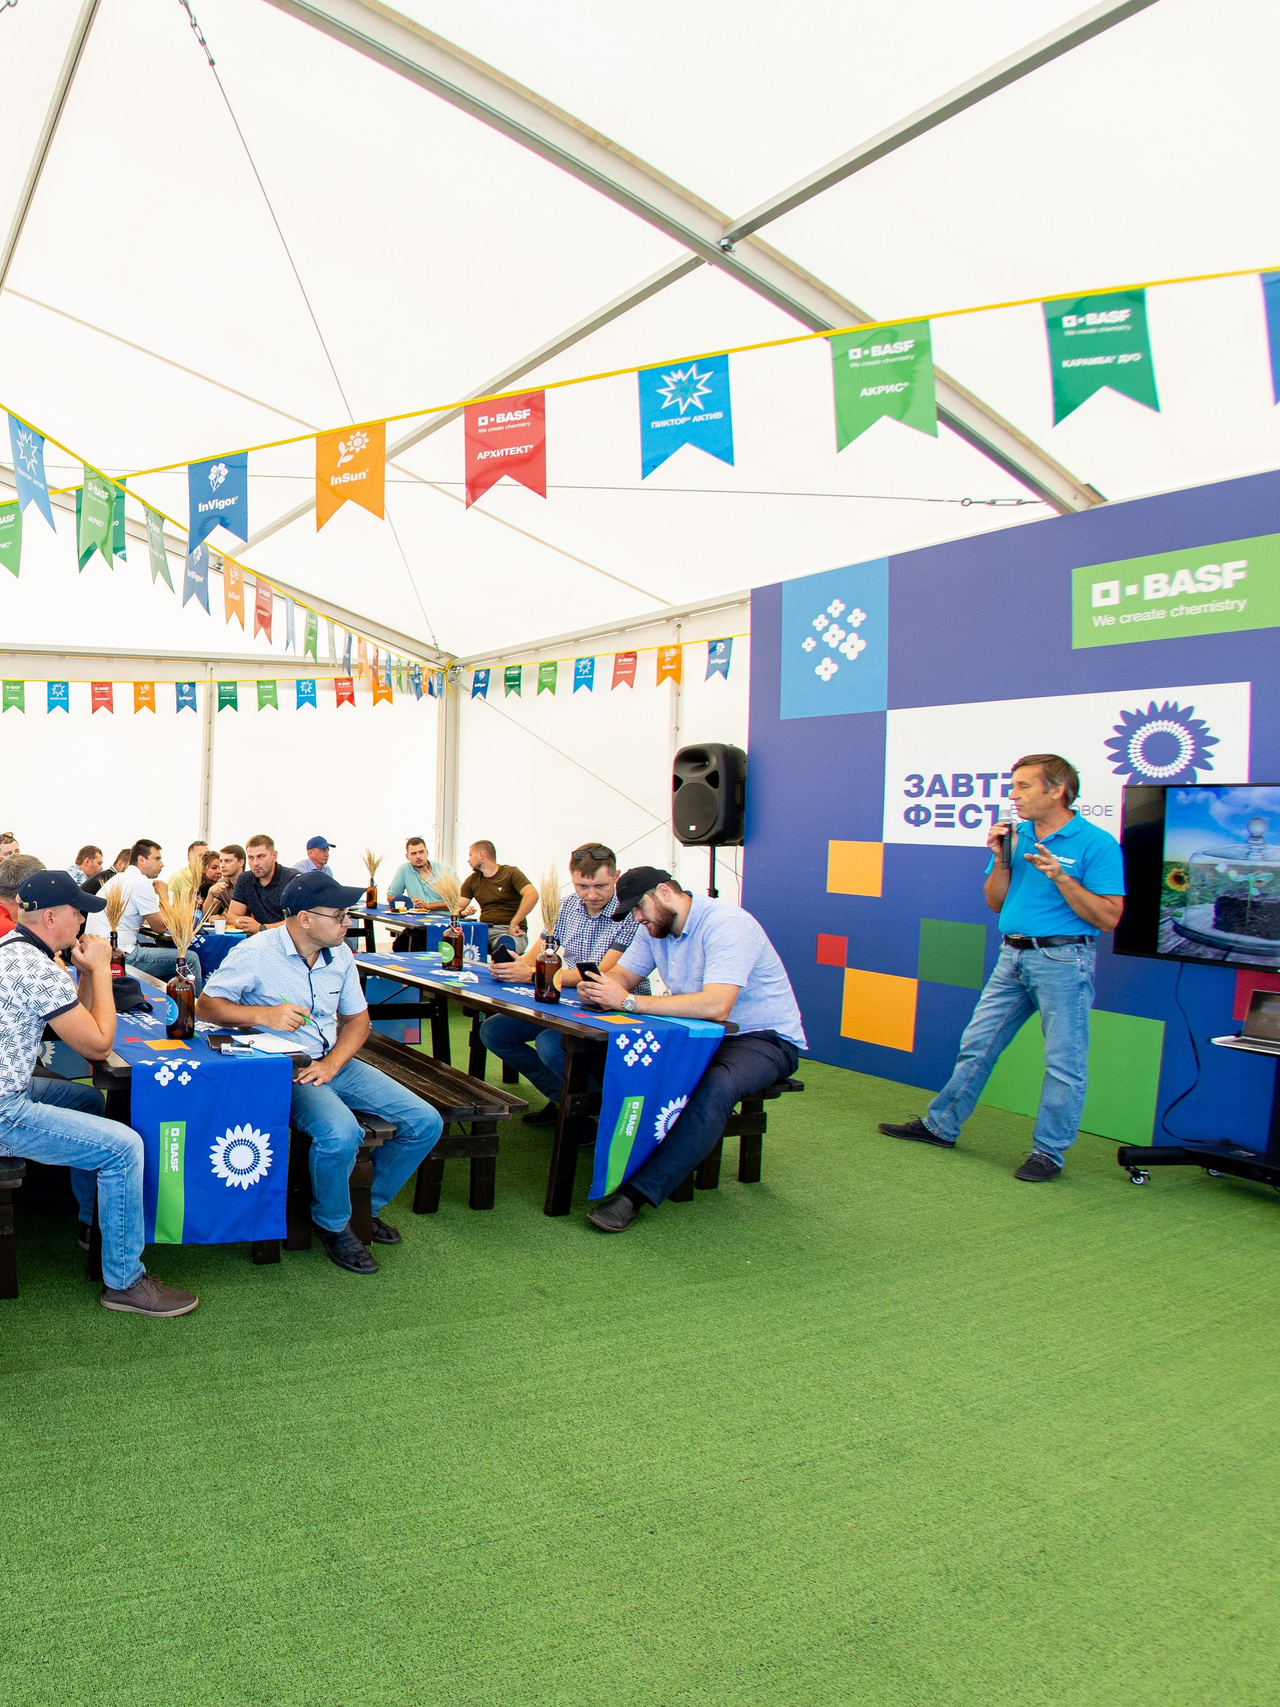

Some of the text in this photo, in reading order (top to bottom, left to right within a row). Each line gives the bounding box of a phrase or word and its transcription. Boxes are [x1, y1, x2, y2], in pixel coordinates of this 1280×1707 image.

[1085, 308, 1131, 326] BASF
[870, 339, 915, 357] BASF
[496, 409, 531, 424] BASF
[691, 411, 724, 424] АКТИВ
[477, 420, 531, 435] We create chemistry
[1143, 559, 1249, 601] BASF
[1092, 598, 1248, 627] We create chemistry
[625, 1114, 637, 1137] BASF
[170, 1142, 179, 1172] BASF
